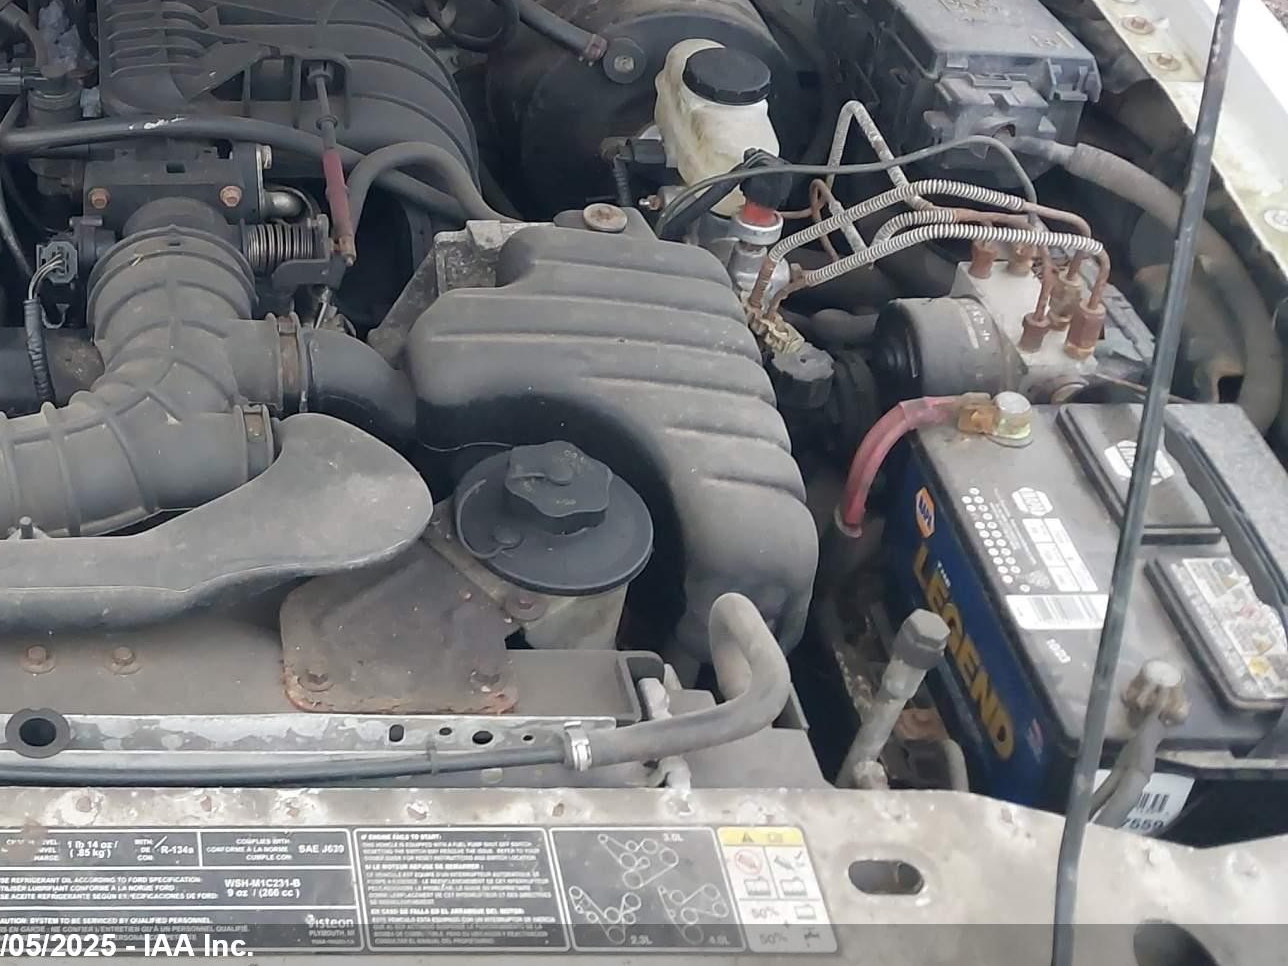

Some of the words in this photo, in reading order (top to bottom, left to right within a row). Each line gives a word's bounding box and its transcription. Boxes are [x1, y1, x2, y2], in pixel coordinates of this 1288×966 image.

[914, 542, 1015, 761] LEGEND
[160, 845, 194, 854] R-134a
[298, 845, 320, 854] SAE
[321, 845, 345, 854] J639
[224, 878, 301, 888] WSH-M1C231-B
[630, 936, 653, 945] 2.3L
